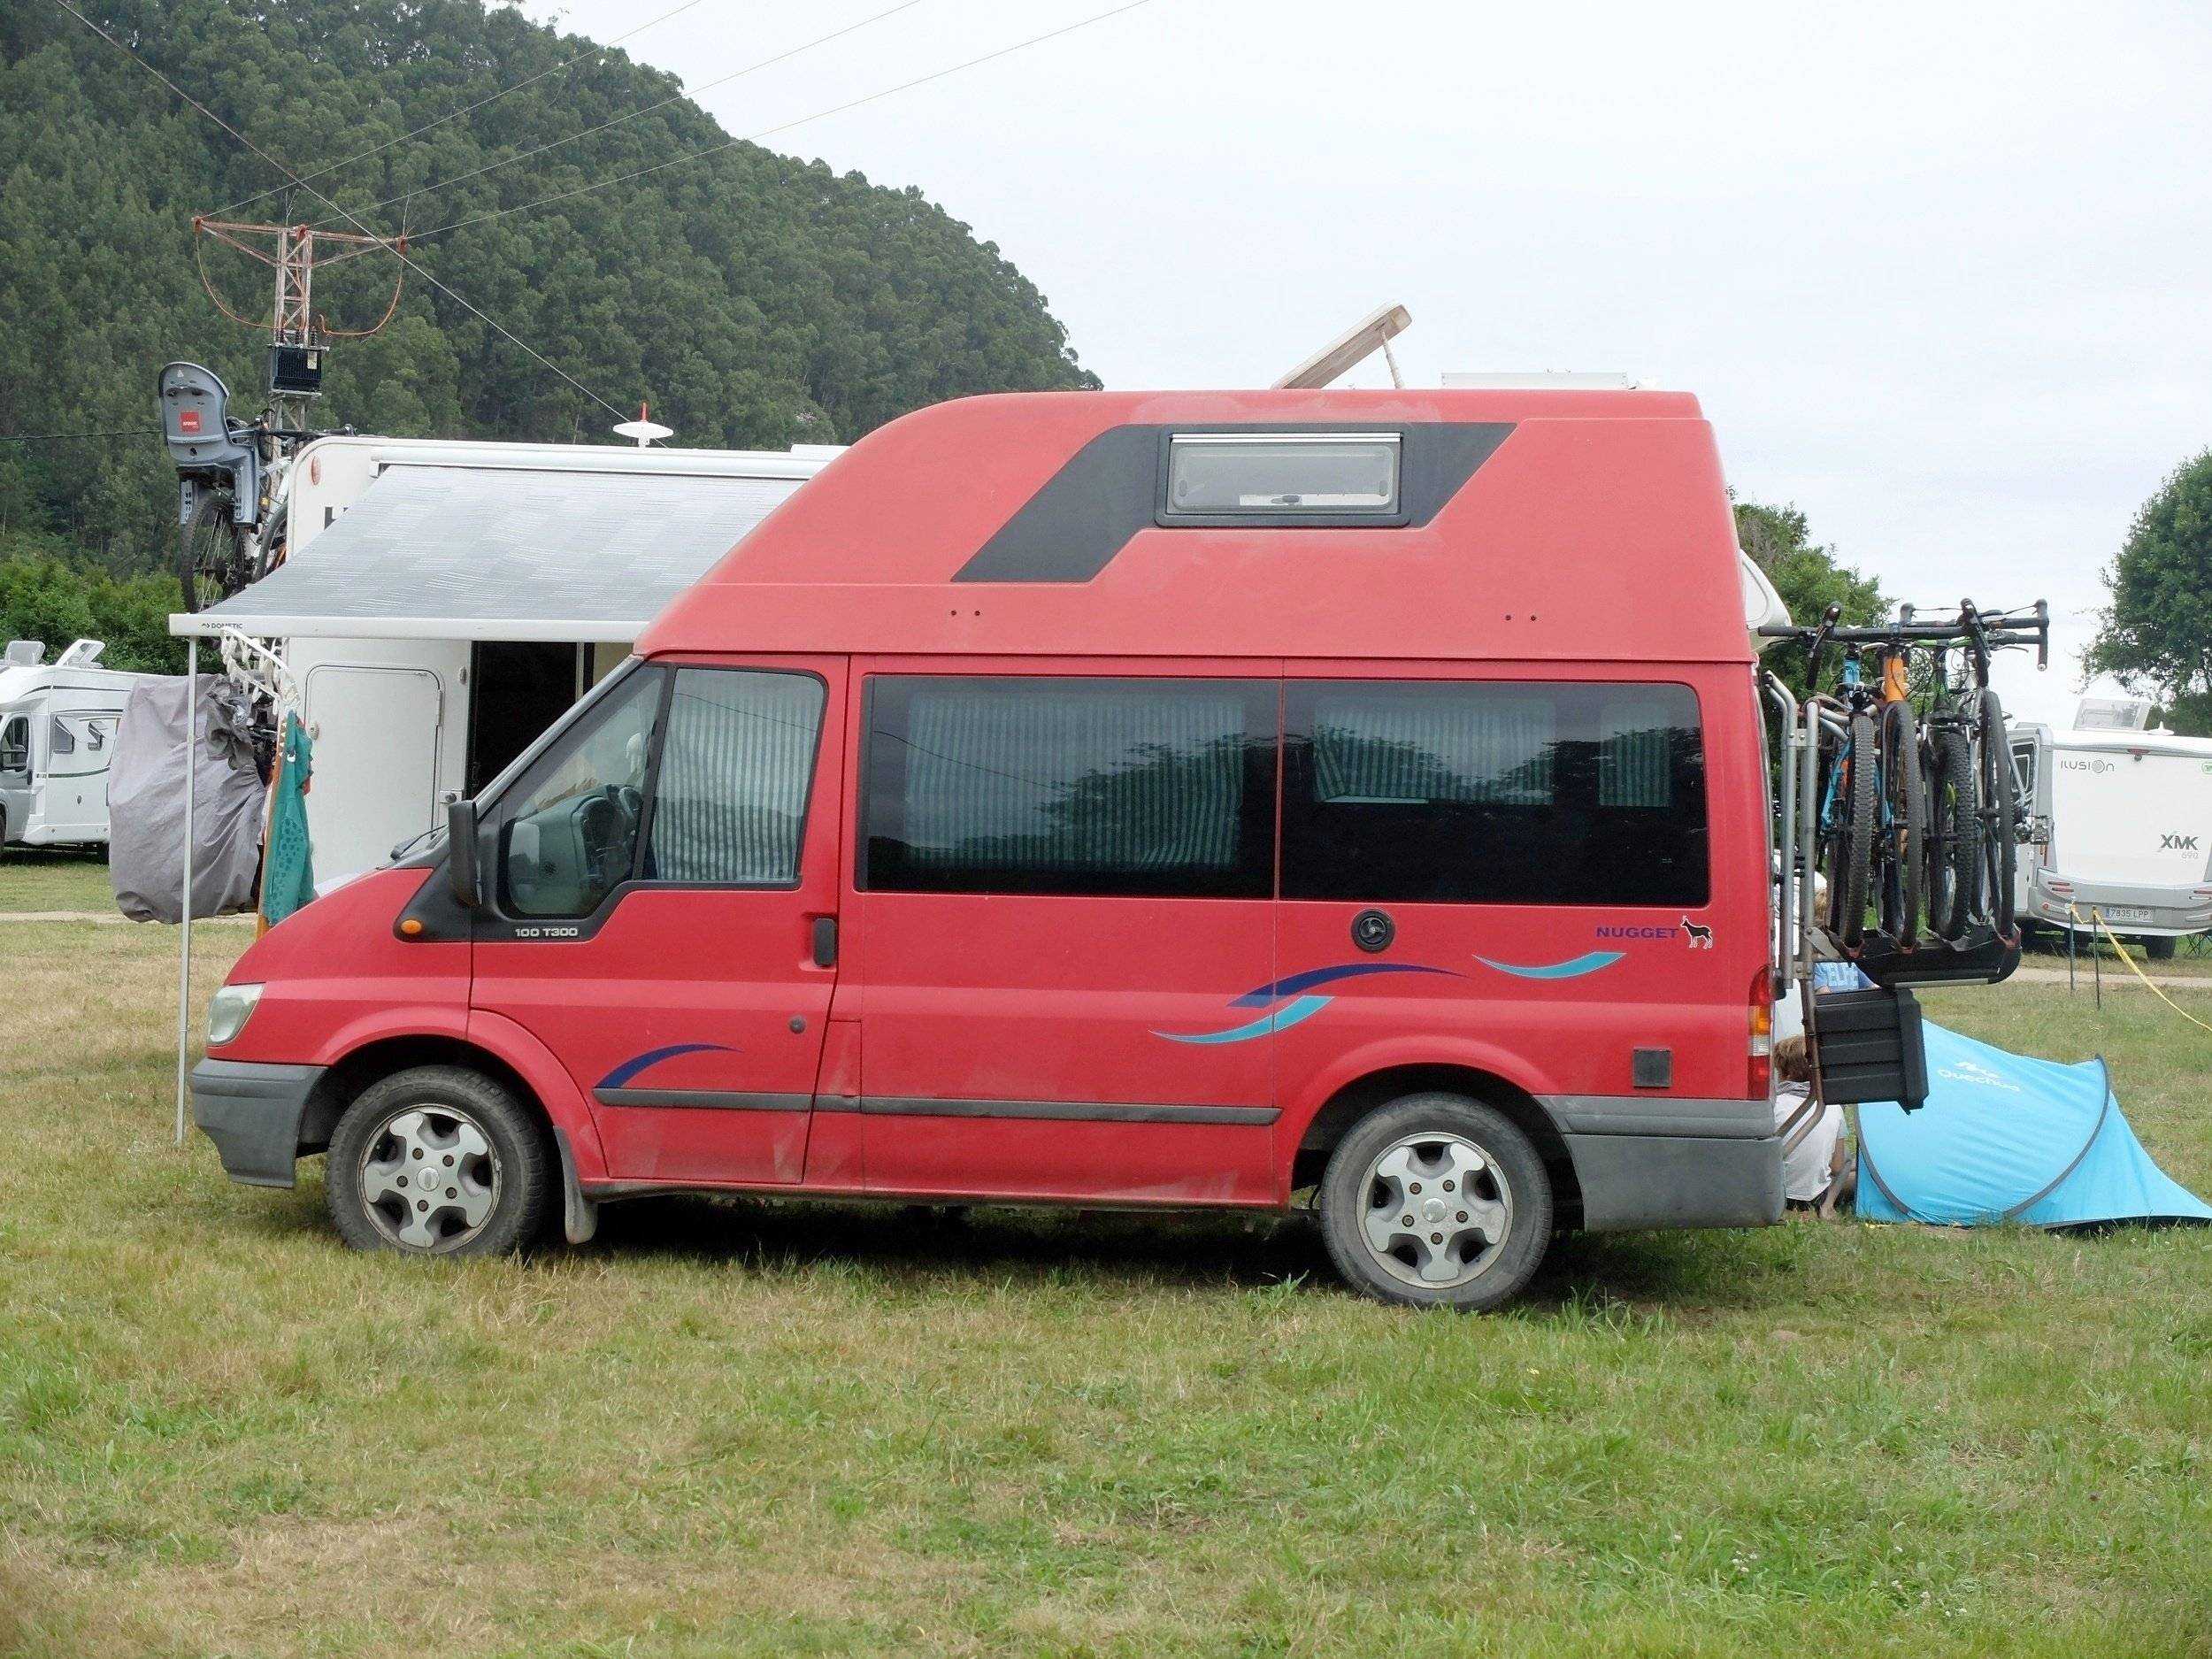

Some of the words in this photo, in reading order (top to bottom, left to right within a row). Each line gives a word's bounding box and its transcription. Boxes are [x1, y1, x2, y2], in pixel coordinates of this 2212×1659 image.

[2159, 833, 2200, 851] XMK
[515, 927, 541, 938] 100
[541, 927, 579, 938] T300
[1596, 926, 1679, 939] NUGGET
